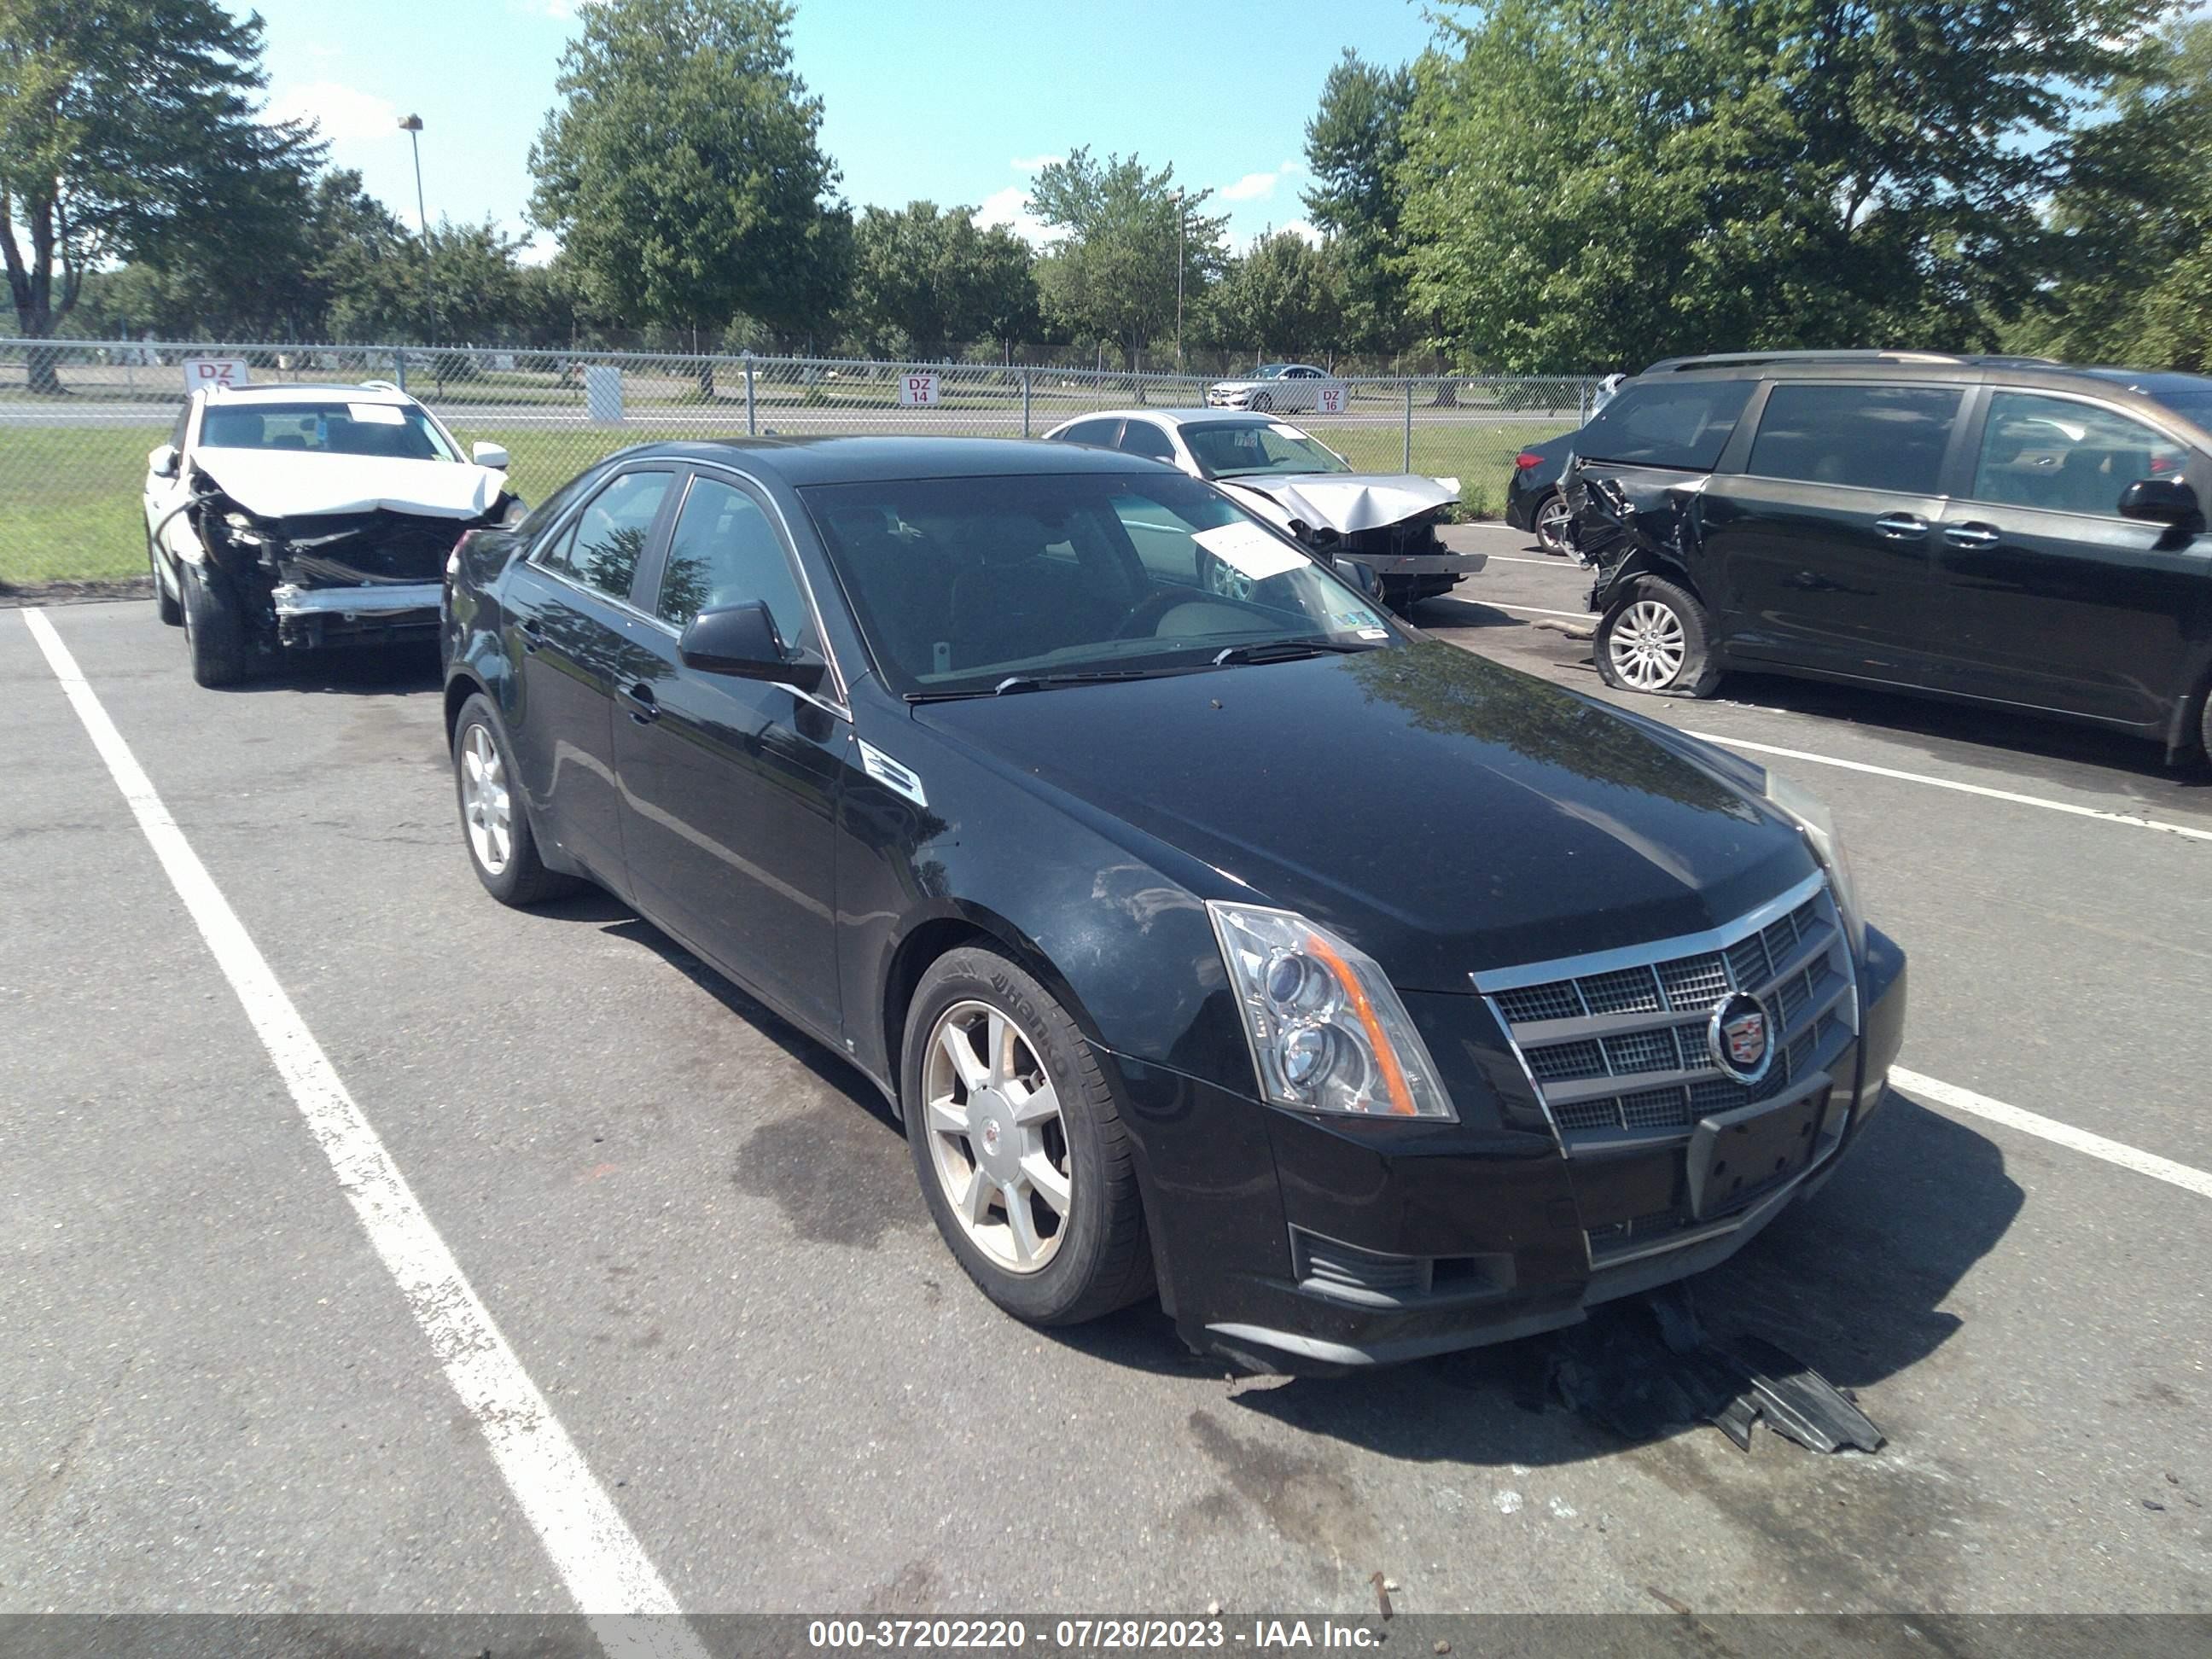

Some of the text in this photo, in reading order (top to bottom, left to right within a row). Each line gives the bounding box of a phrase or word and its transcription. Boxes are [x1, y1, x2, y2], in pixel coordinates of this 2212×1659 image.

[198, 364, 235, 378] DZ
[910, 379, 930, 390] DZ
[911, 392, 928, 402] 14
[1324, 391, 1339, 400] DZ
[1326, 401, 1337, 410] 16
